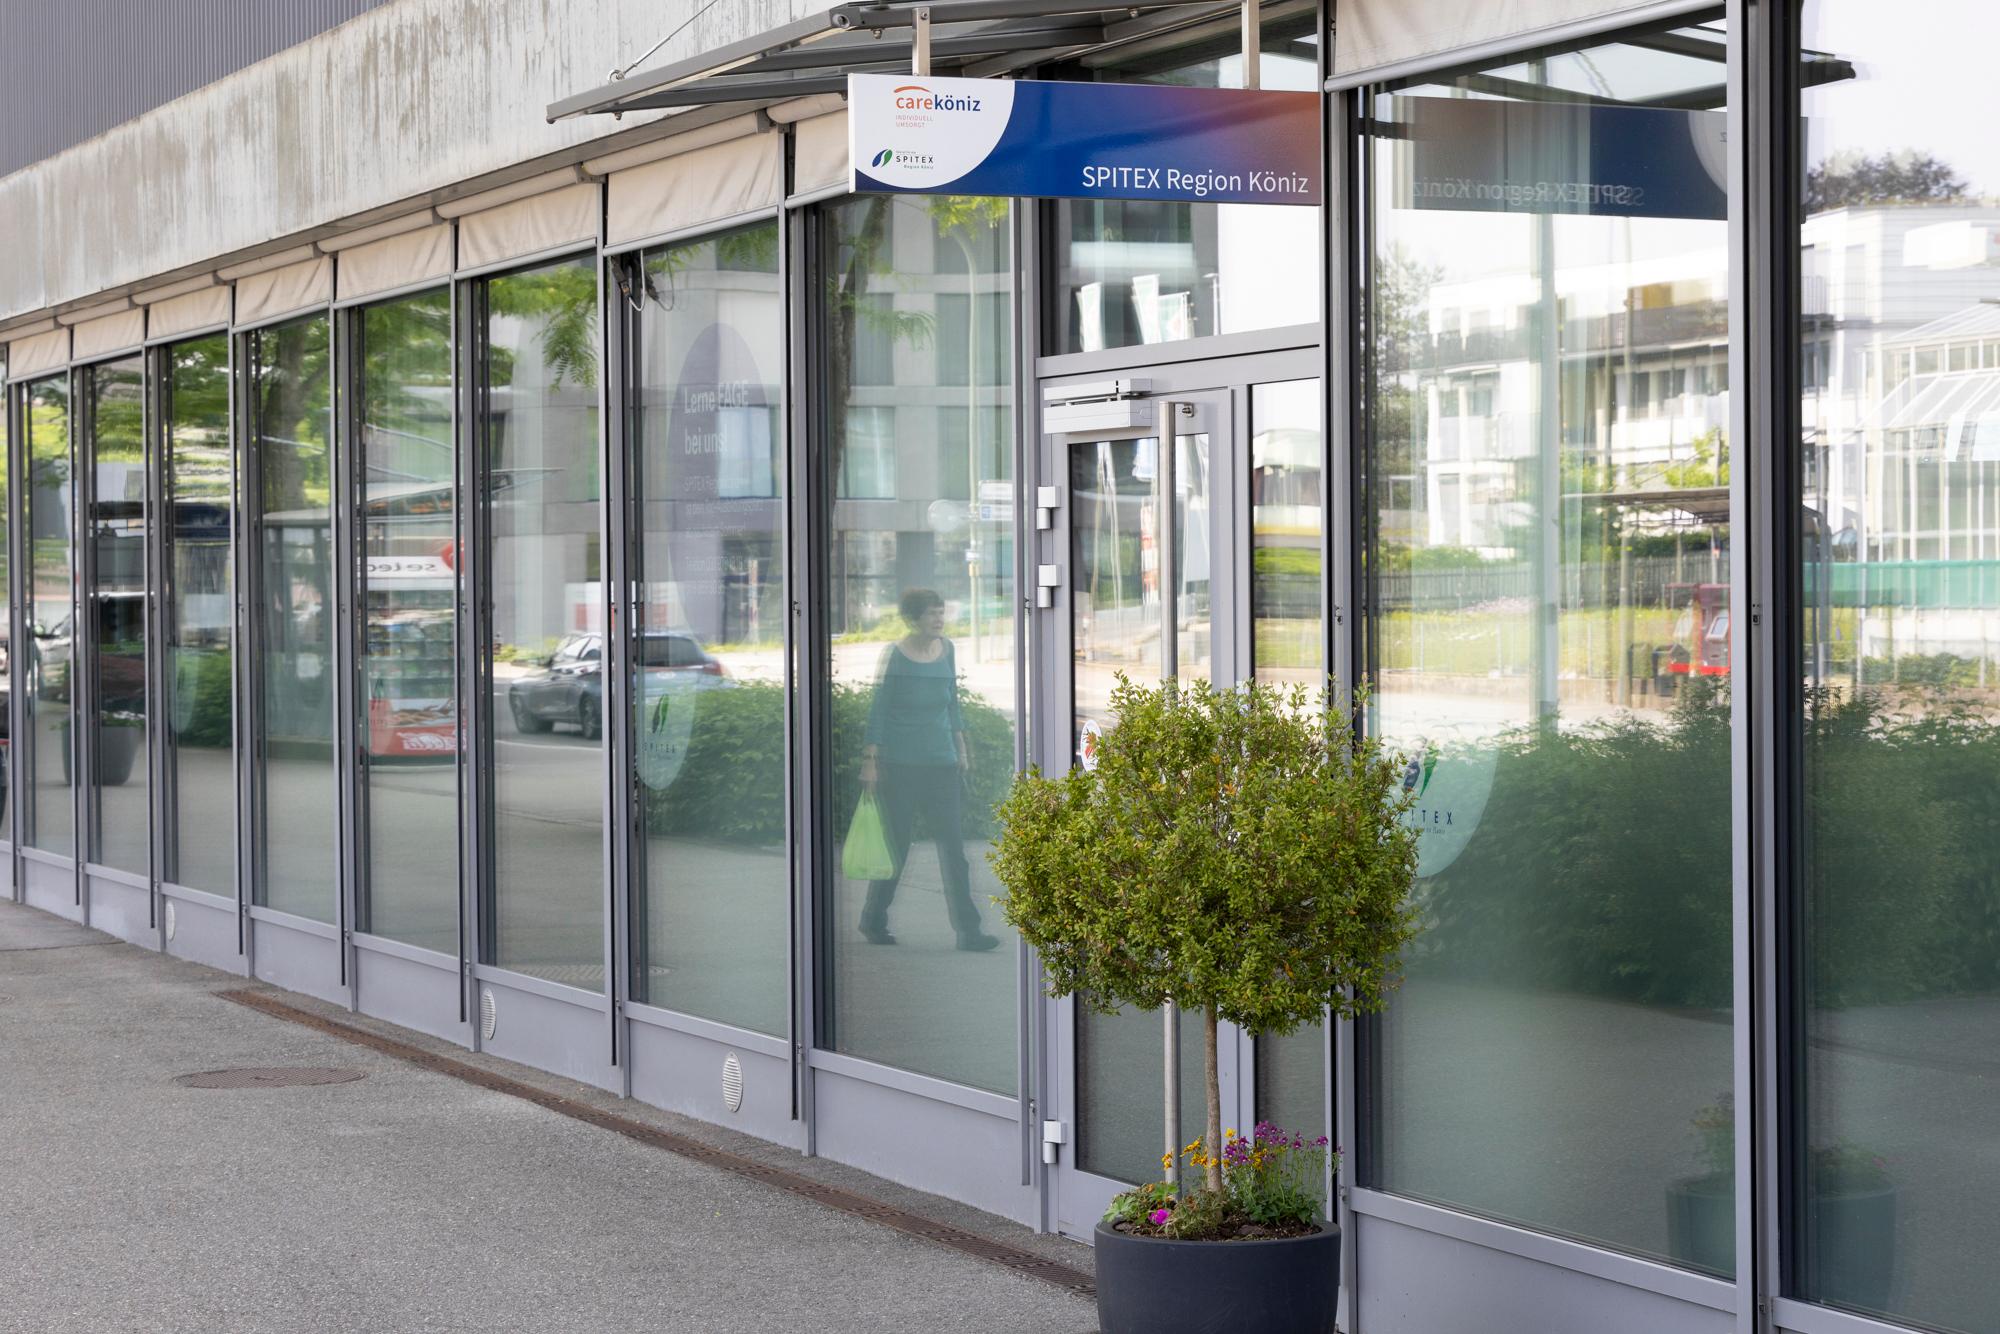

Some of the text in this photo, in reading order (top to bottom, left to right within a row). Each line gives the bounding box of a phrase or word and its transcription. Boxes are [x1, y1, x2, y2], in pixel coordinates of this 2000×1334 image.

[895, 94, 981, 111] careköniz
[895, 155, 934, 164] SPITEX
[1082, 166, 1309, 197] SPITEX Region Köniz
[684, 379, 749, 414] Lerne FAGE
[684, 423, 728, 455] bei uns!
